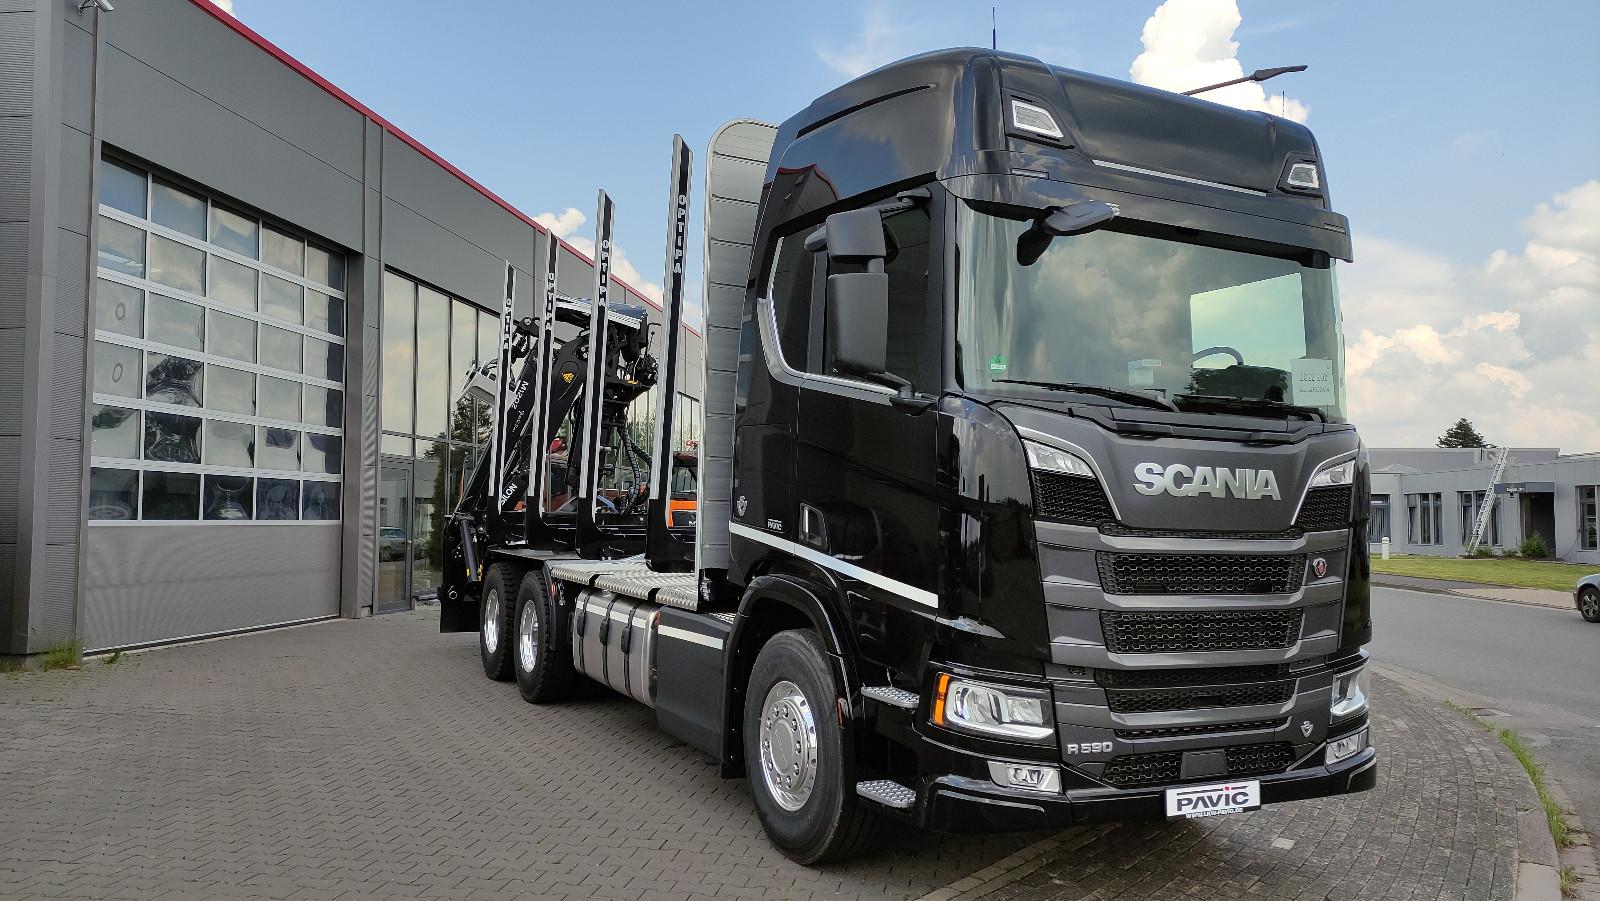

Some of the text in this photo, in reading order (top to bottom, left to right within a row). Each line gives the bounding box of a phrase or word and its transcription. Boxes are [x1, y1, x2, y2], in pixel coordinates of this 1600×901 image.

[674, 194, 687, 274] OPTIPA
[599, 240, 609, 307] OPTIPA
[500, 482, 518, 506] SILON
[1133, 462, 1281, 501] SCANIA
[1067, 741, 1113, 755] R 590
